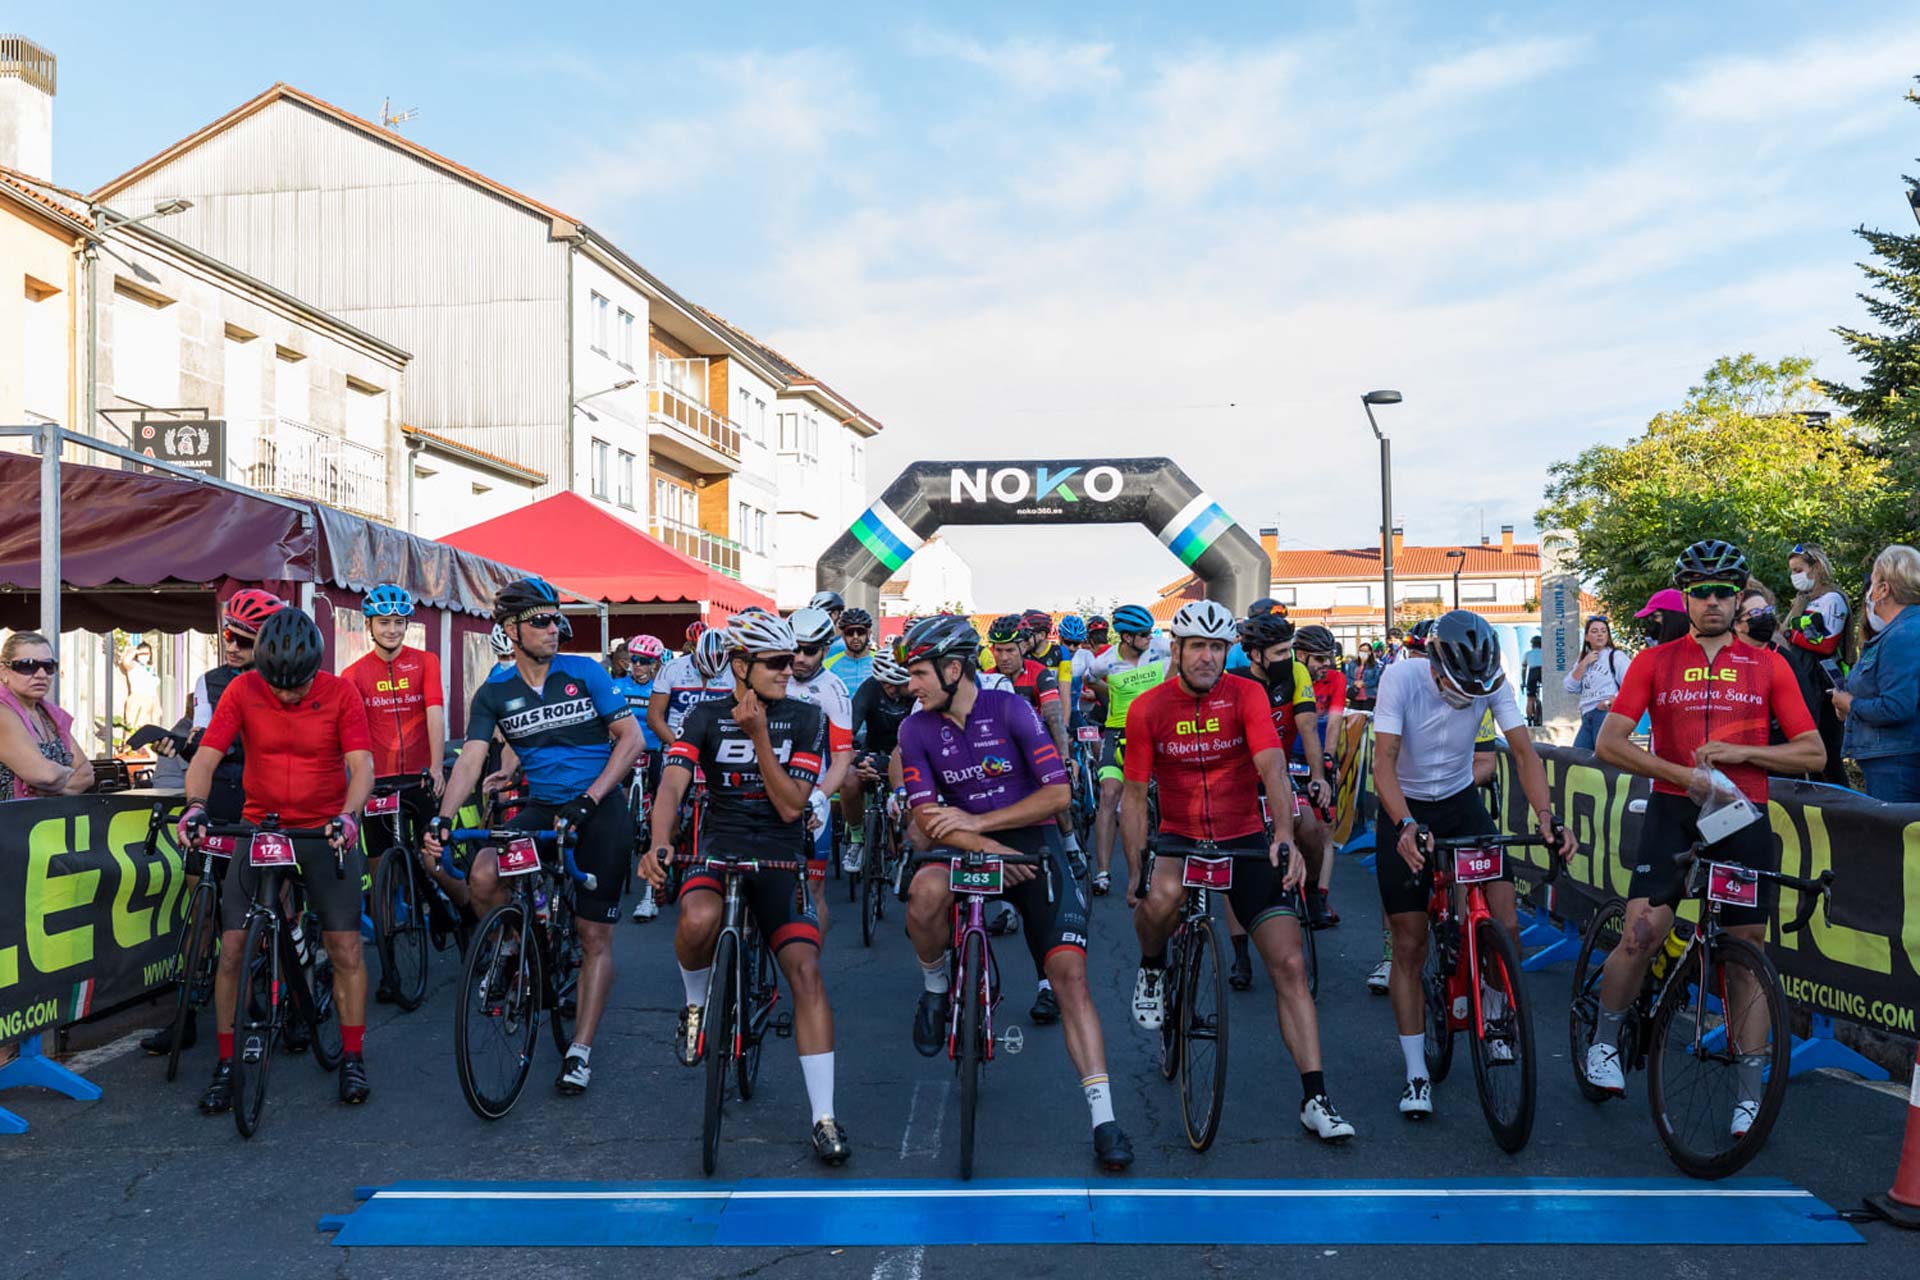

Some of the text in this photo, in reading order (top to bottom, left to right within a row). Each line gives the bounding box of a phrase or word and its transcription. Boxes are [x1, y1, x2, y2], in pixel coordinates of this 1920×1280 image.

[949, 466, 1124, 503] NOKO
[503, 710, 540, 731] DUAS
[543, 700, 592, 719] RODAS
[715, 739, 793, 764] BH
[209, 836, 222, 847] 61
[260, 844, 282, 855] 172
[507, 851, 524, 864] 24
[1468, 859, 1491, 871] 188
[963, 872, 990, 884] 263
[1205, 871, 1213, 881] 1
[1062, 932, 1087, 947] BH
